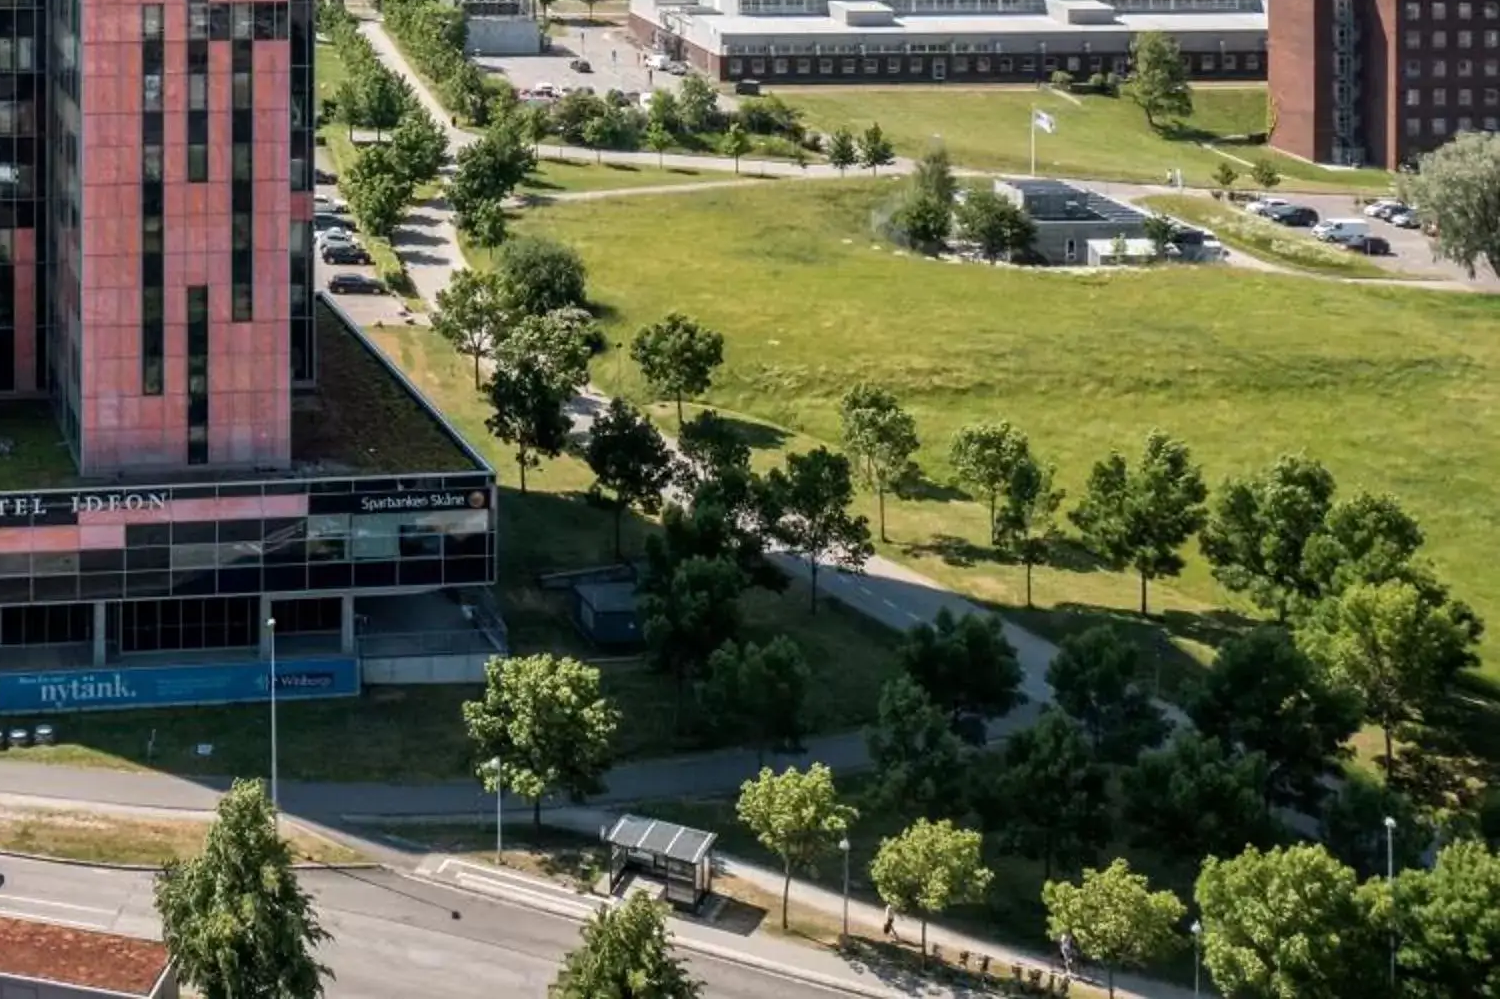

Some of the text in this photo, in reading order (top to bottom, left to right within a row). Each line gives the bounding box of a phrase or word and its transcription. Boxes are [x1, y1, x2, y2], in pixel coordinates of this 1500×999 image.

[70, 492, 167, 514] IDEON
[361, 492, 465, 511] Sparbanken Skåne
